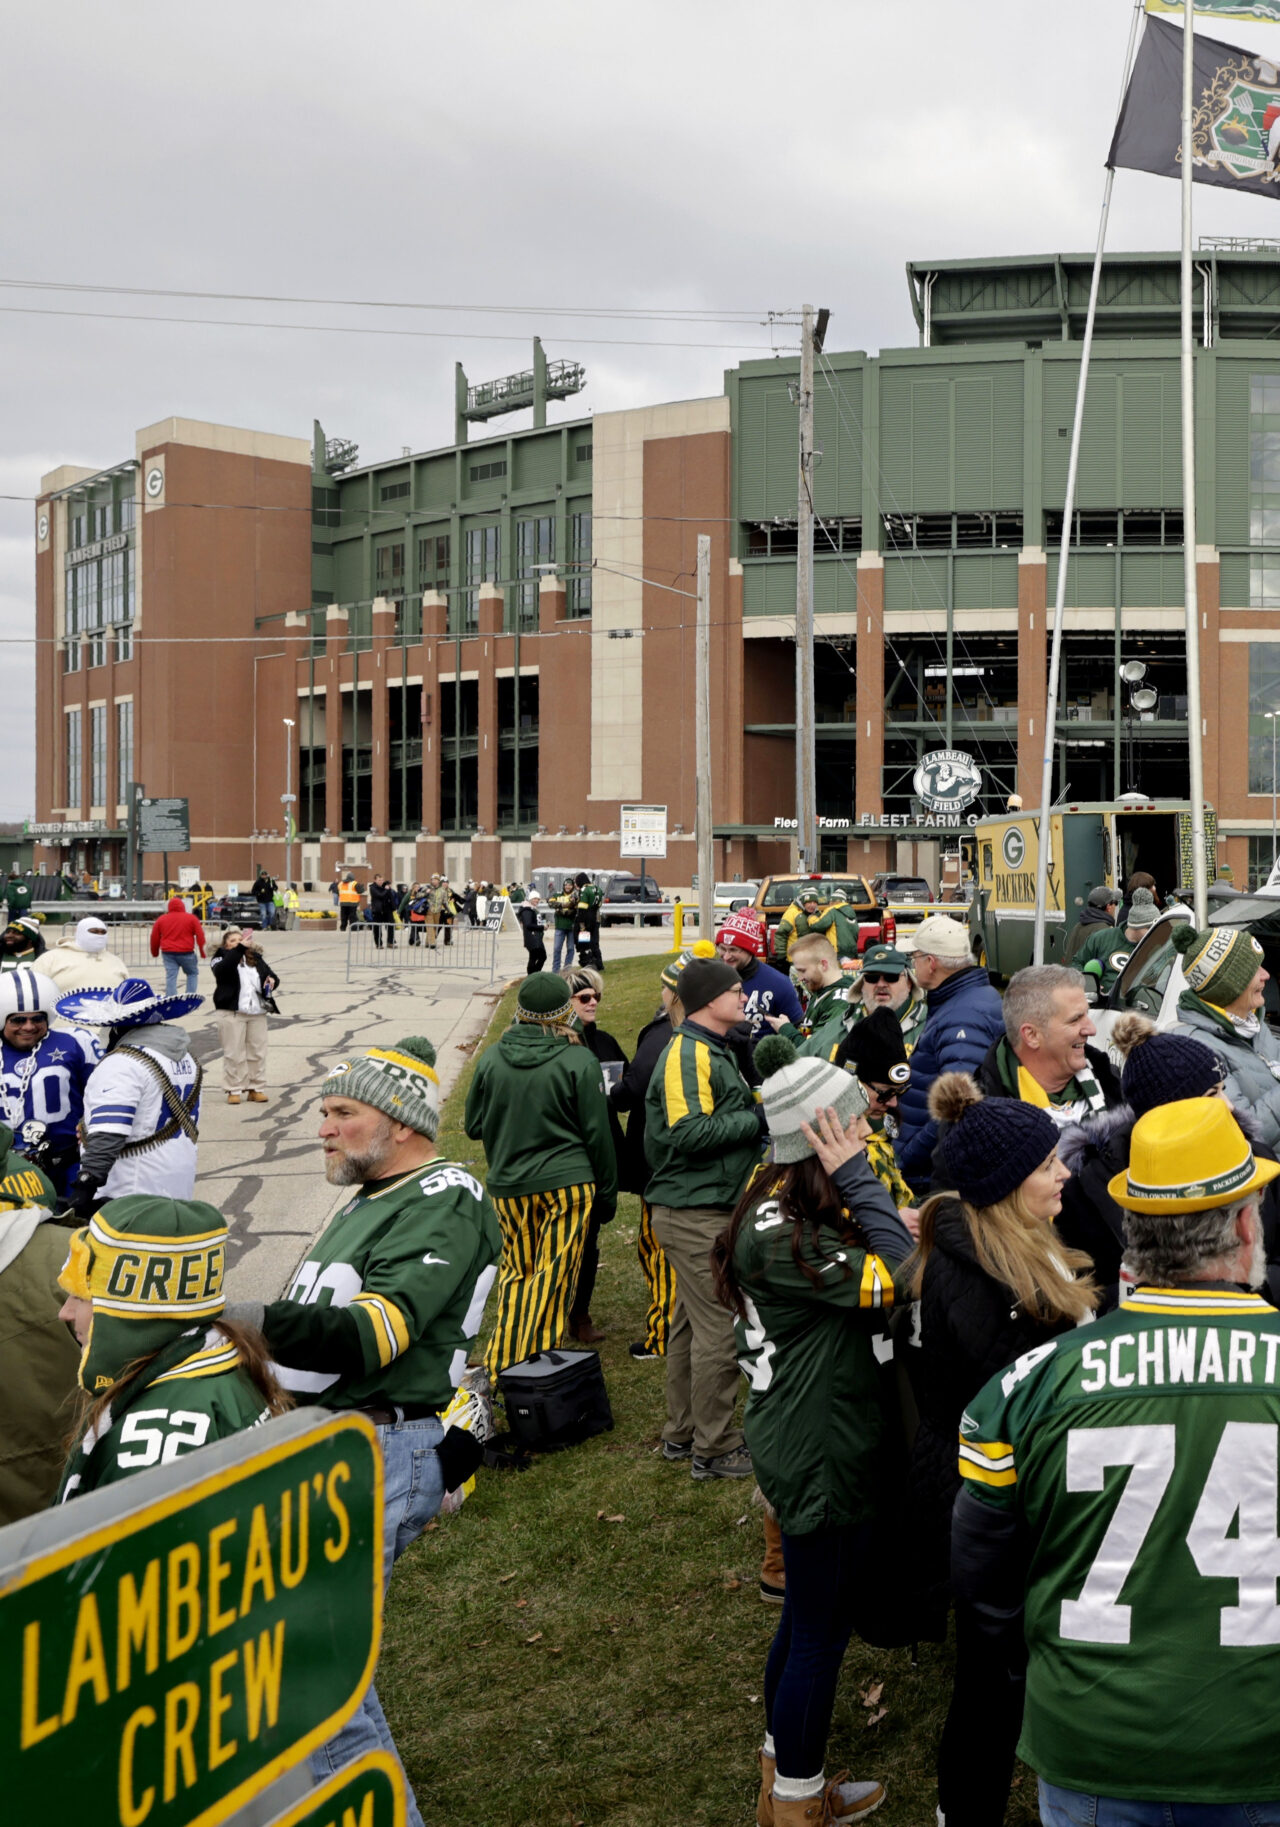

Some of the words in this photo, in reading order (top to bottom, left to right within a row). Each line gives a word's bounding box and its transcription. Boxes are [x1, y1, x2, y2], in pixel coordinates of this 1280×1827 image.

[925, 752, 970, 766] LAMBEAU
[932, 801, 961, 812] FIELD
[818, 816, 850, 829] Farm
[861, 814, 909, 829] FLEET
[916, 814, 961, 828] FARM
[995, 872, 1037, 903] PACKERS
[1205, 927, 1234, 962] GREE
[170, 1060, 193, 1076] LAMB
[0, 1170, 45, 1198] TIARI
[106, 1244, 226, 1301] GREE
[117, 1408, 211, 1469] 52
[21, 1461, 350, 1751] LAMBEAU'S
[118, 1619, 285, 1827] CREW
